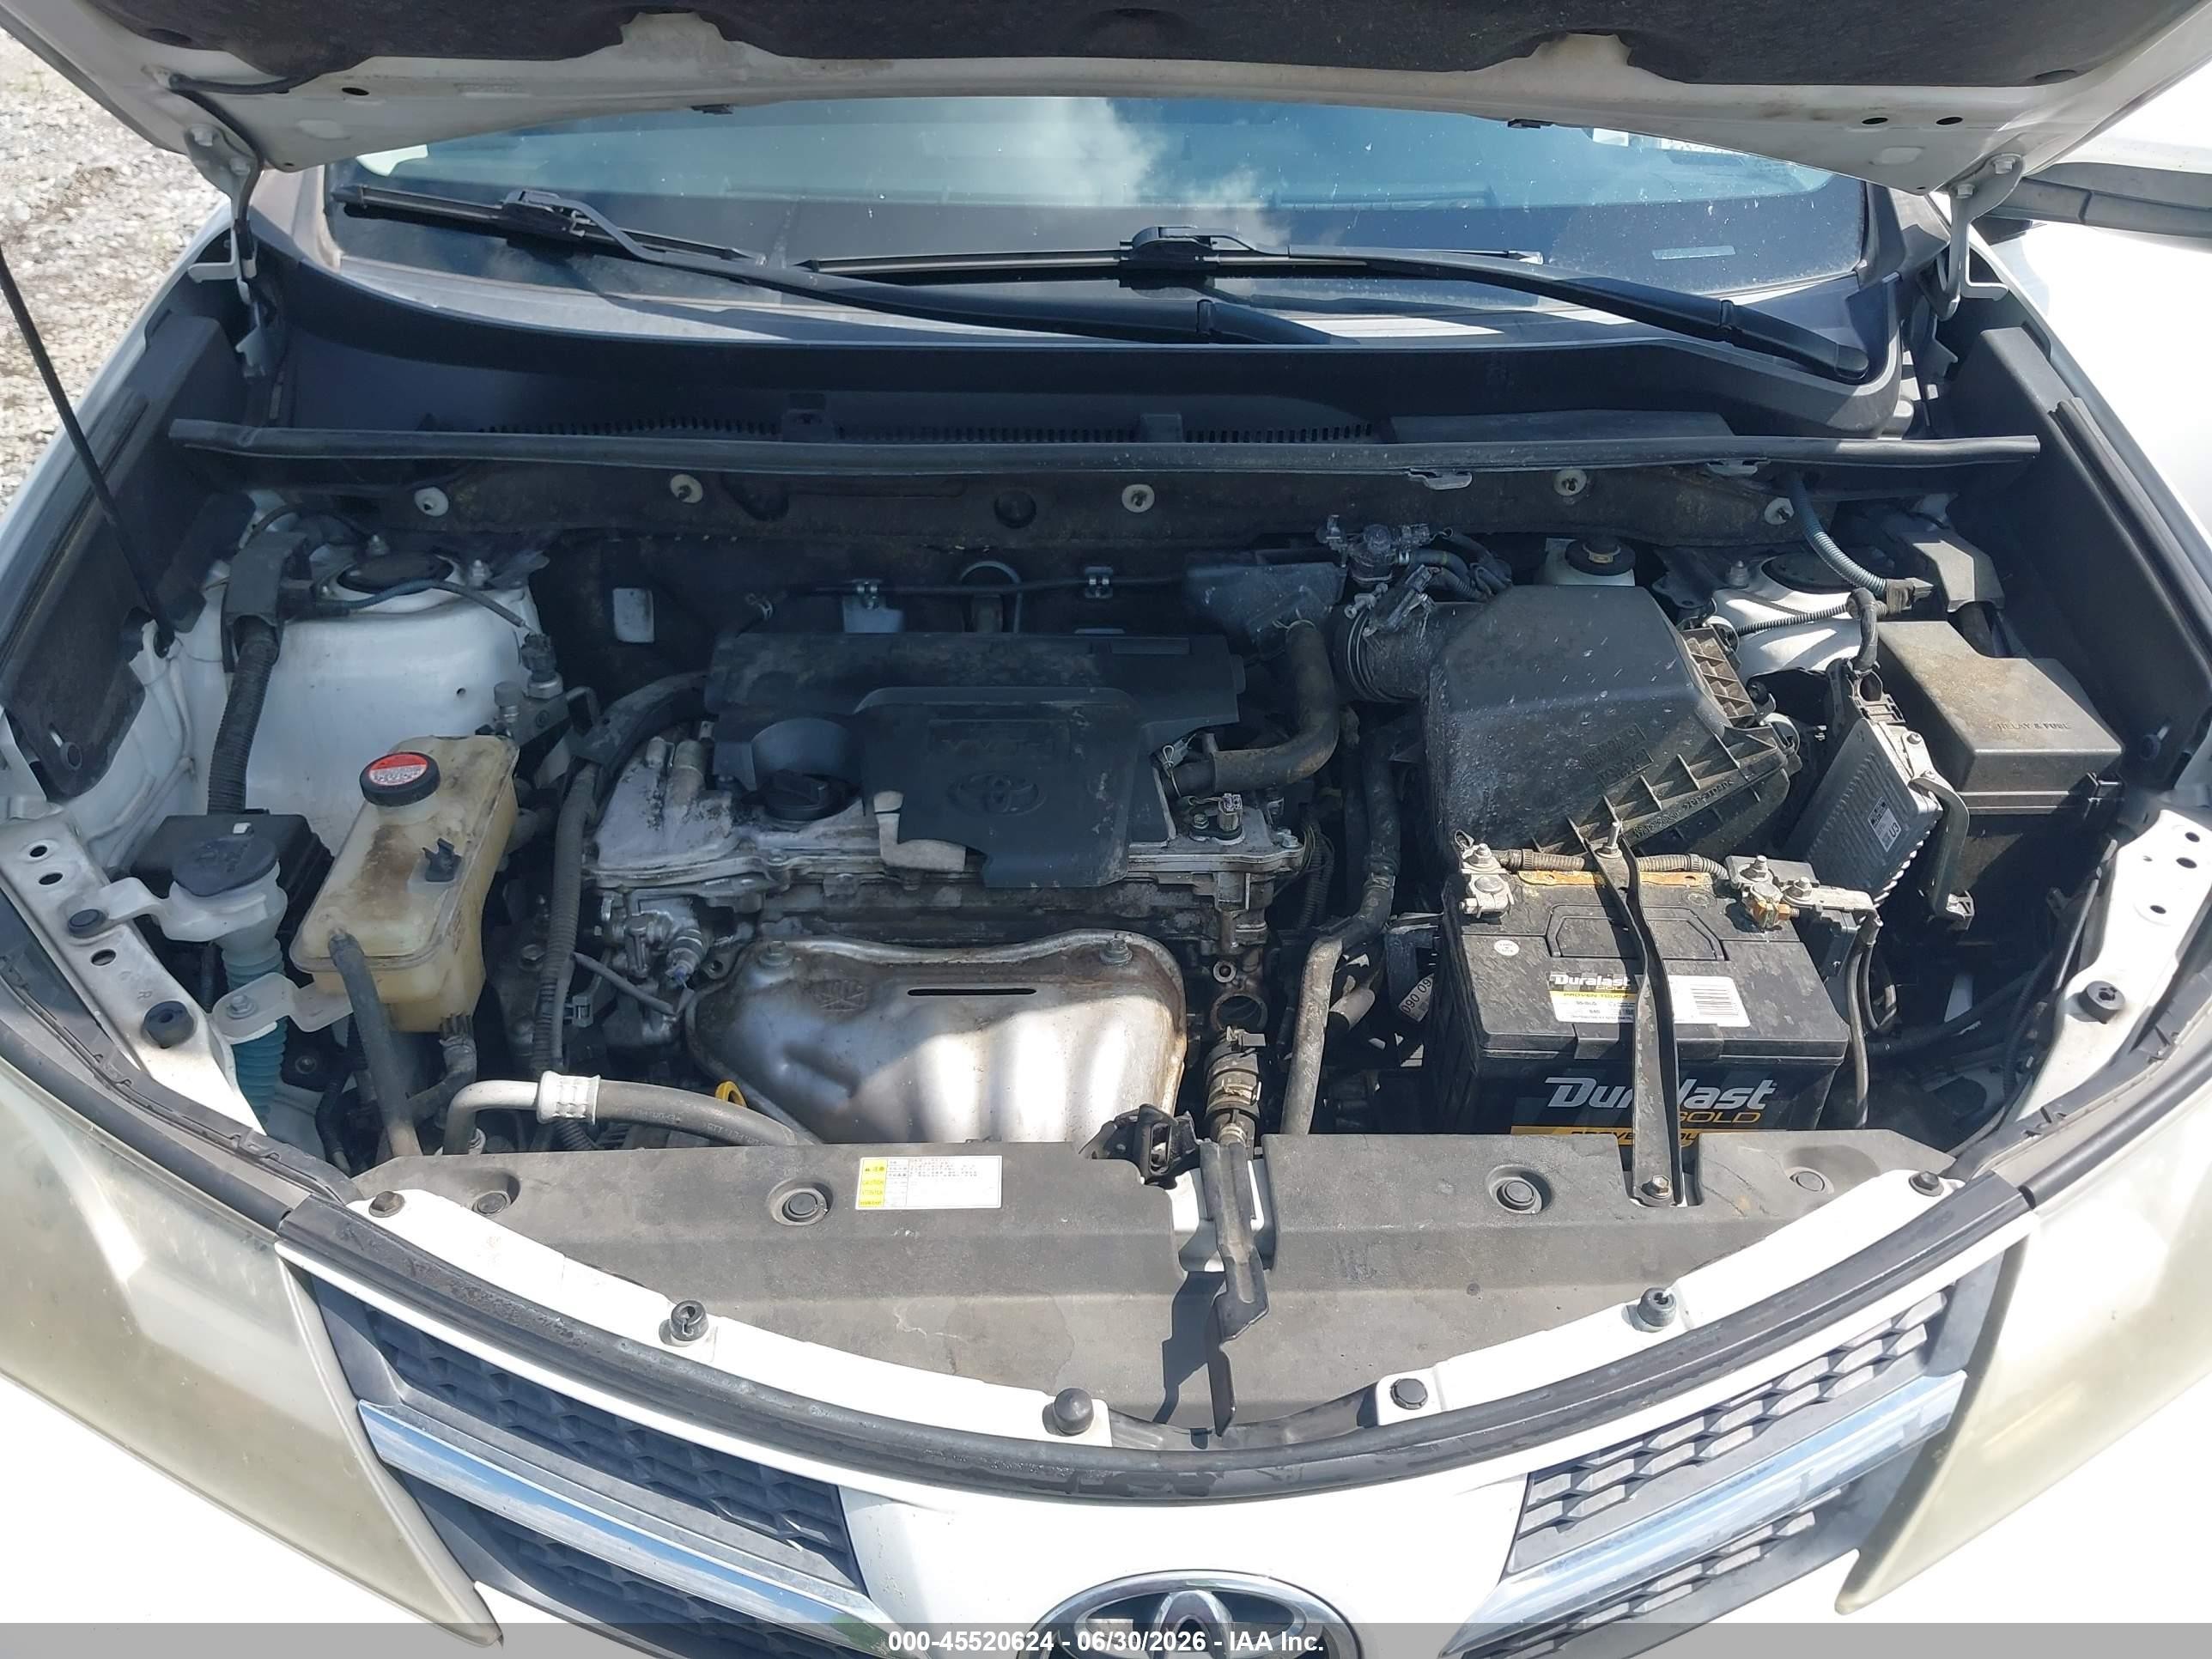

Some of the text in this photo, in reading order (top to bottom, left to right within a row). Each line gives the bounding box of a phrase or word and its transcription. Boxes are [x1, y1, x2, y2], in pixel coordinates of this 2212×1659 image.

[1888, 822, 1899, 838] U3
[1549, 974, 1631, 987] Duralast
[1545, 1077, 1778, 1110] Durlast
